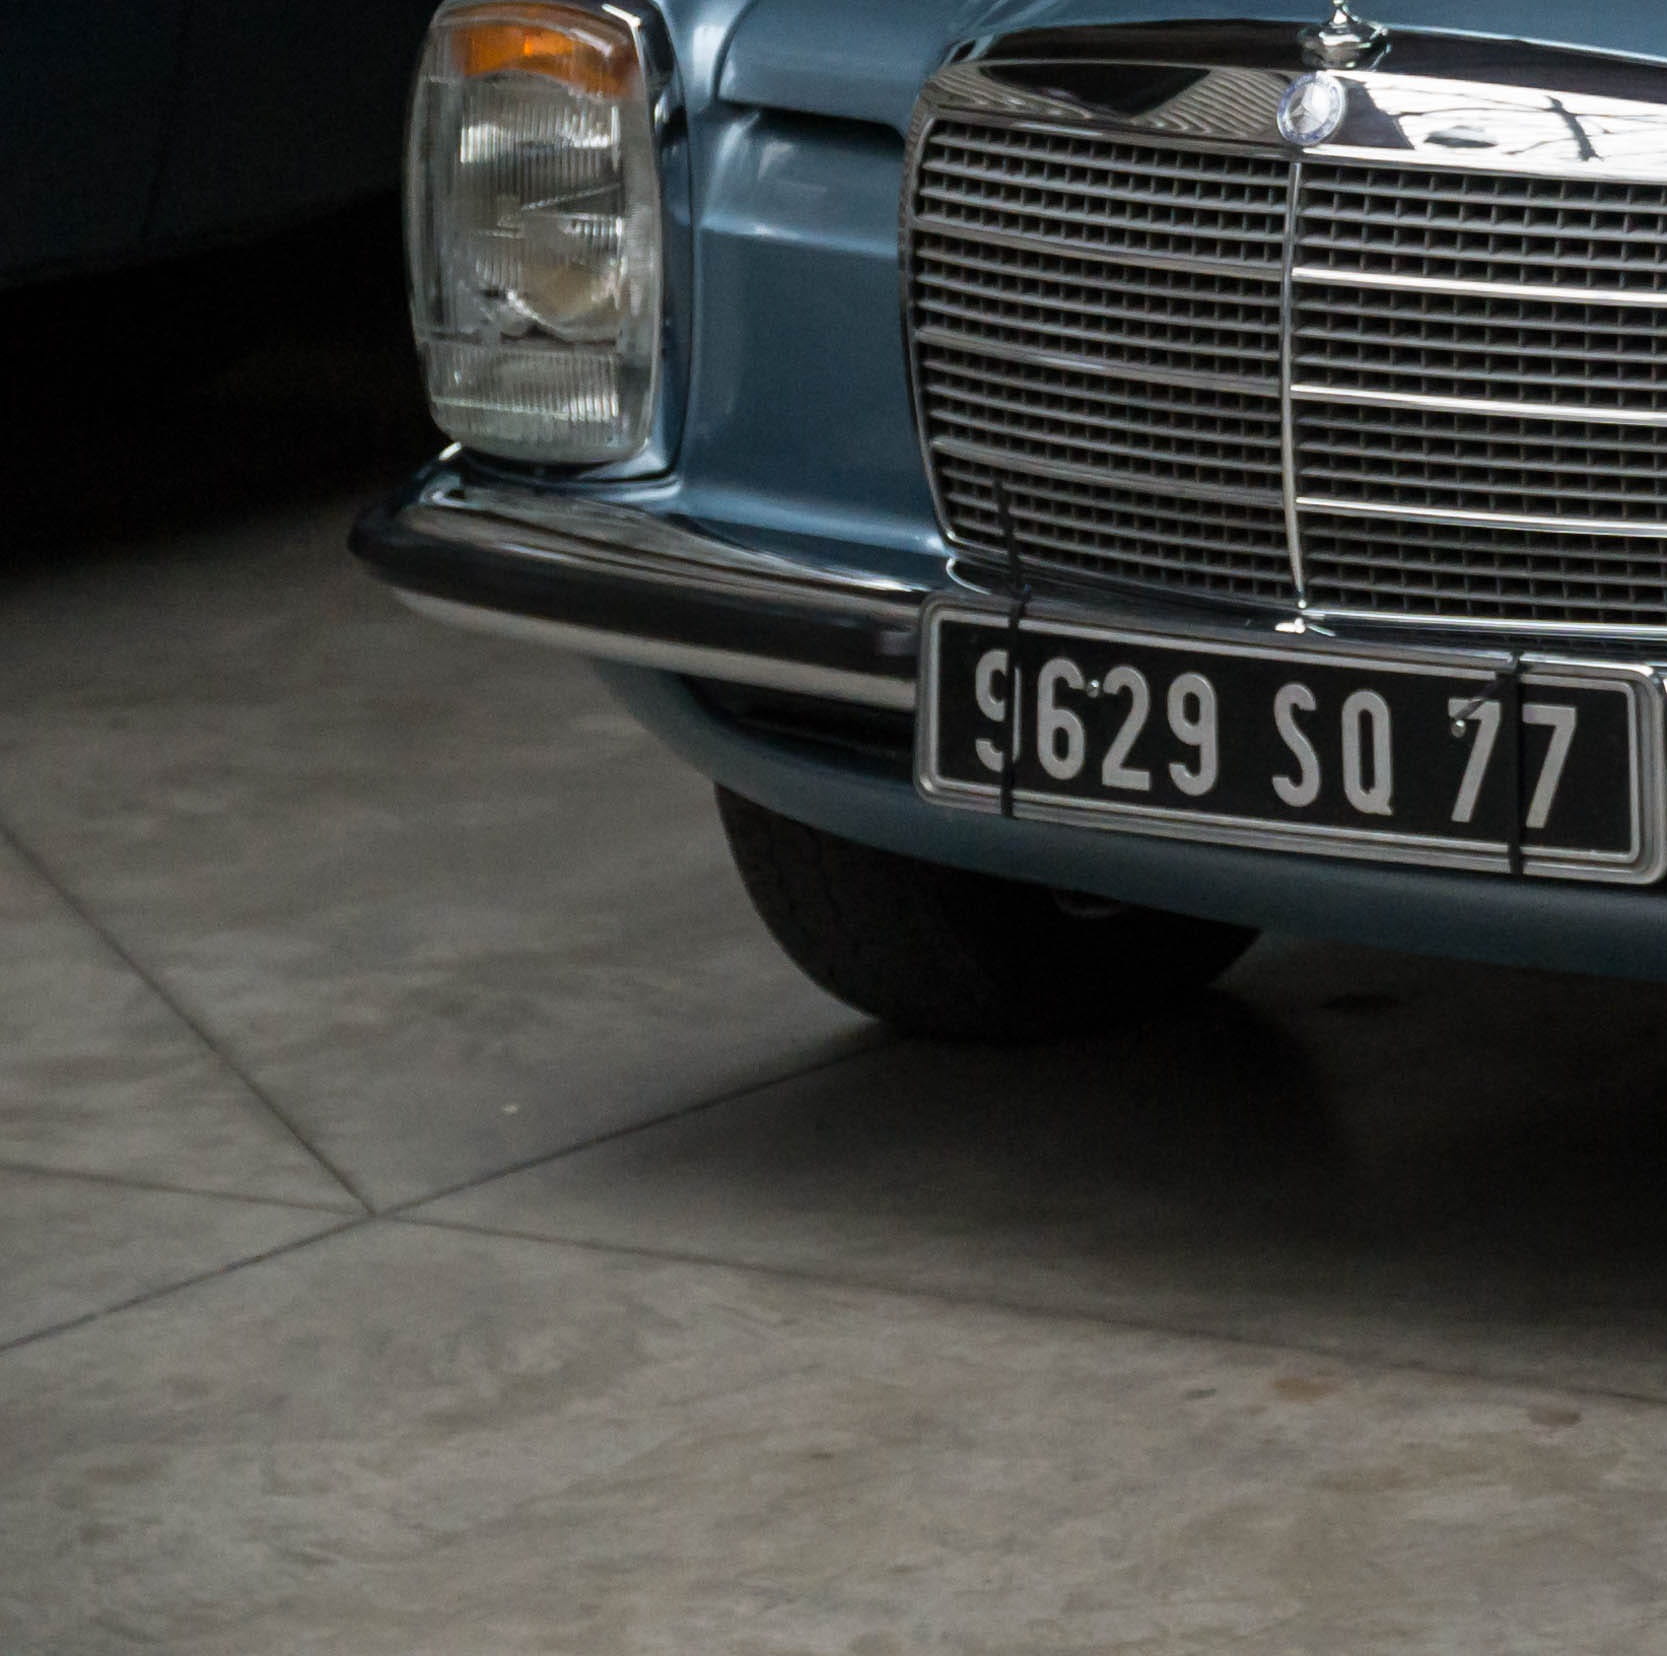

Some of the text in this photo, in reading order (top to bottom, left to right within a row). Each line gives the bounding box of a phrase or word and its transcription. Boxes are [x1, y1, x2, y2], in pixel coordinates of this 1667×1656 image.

[975, 648, 1578, 830] 9629 SQ 77
